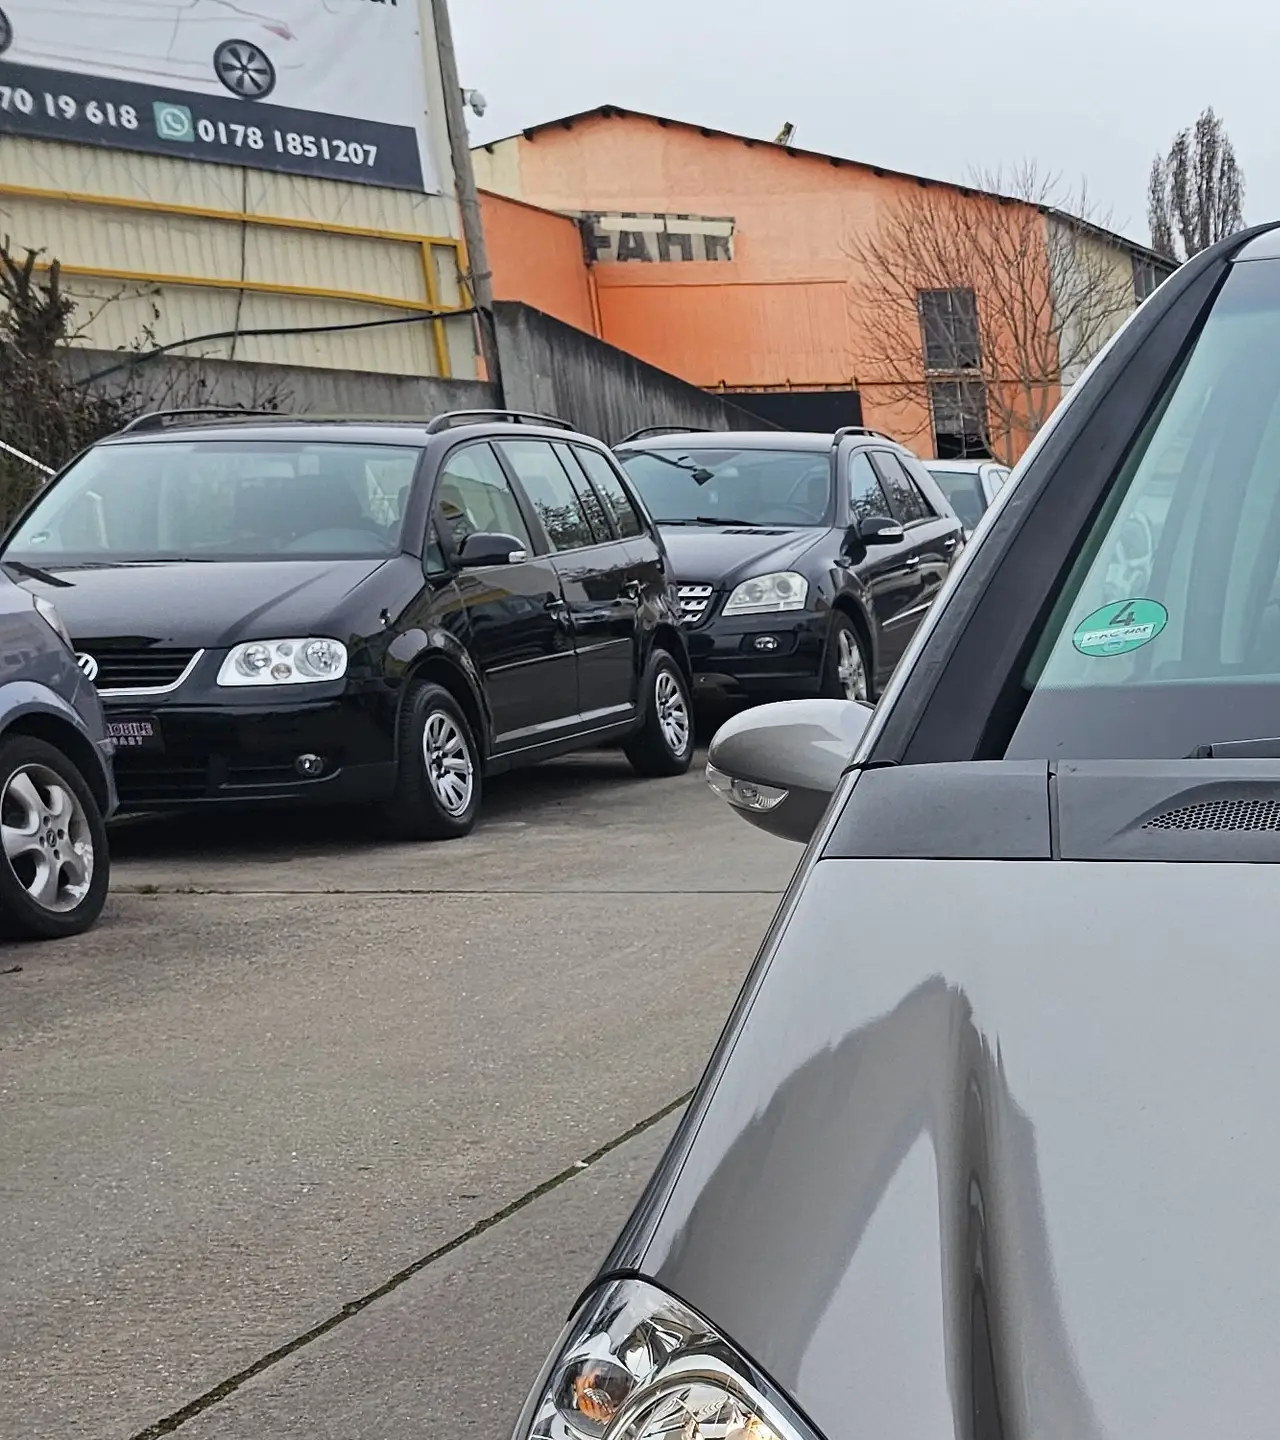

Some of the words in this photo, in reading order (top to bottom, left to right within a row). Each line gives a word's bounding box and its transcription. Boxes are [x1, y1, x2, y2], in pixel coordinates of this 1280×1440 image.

[42, 91, 77, 120] 19
[85, 100, 139, 130] 618
[198, 119, 264, 150] 0178
[273, 129, 378, 167] 1851207
[1109, 601, 1136, 626] 4
